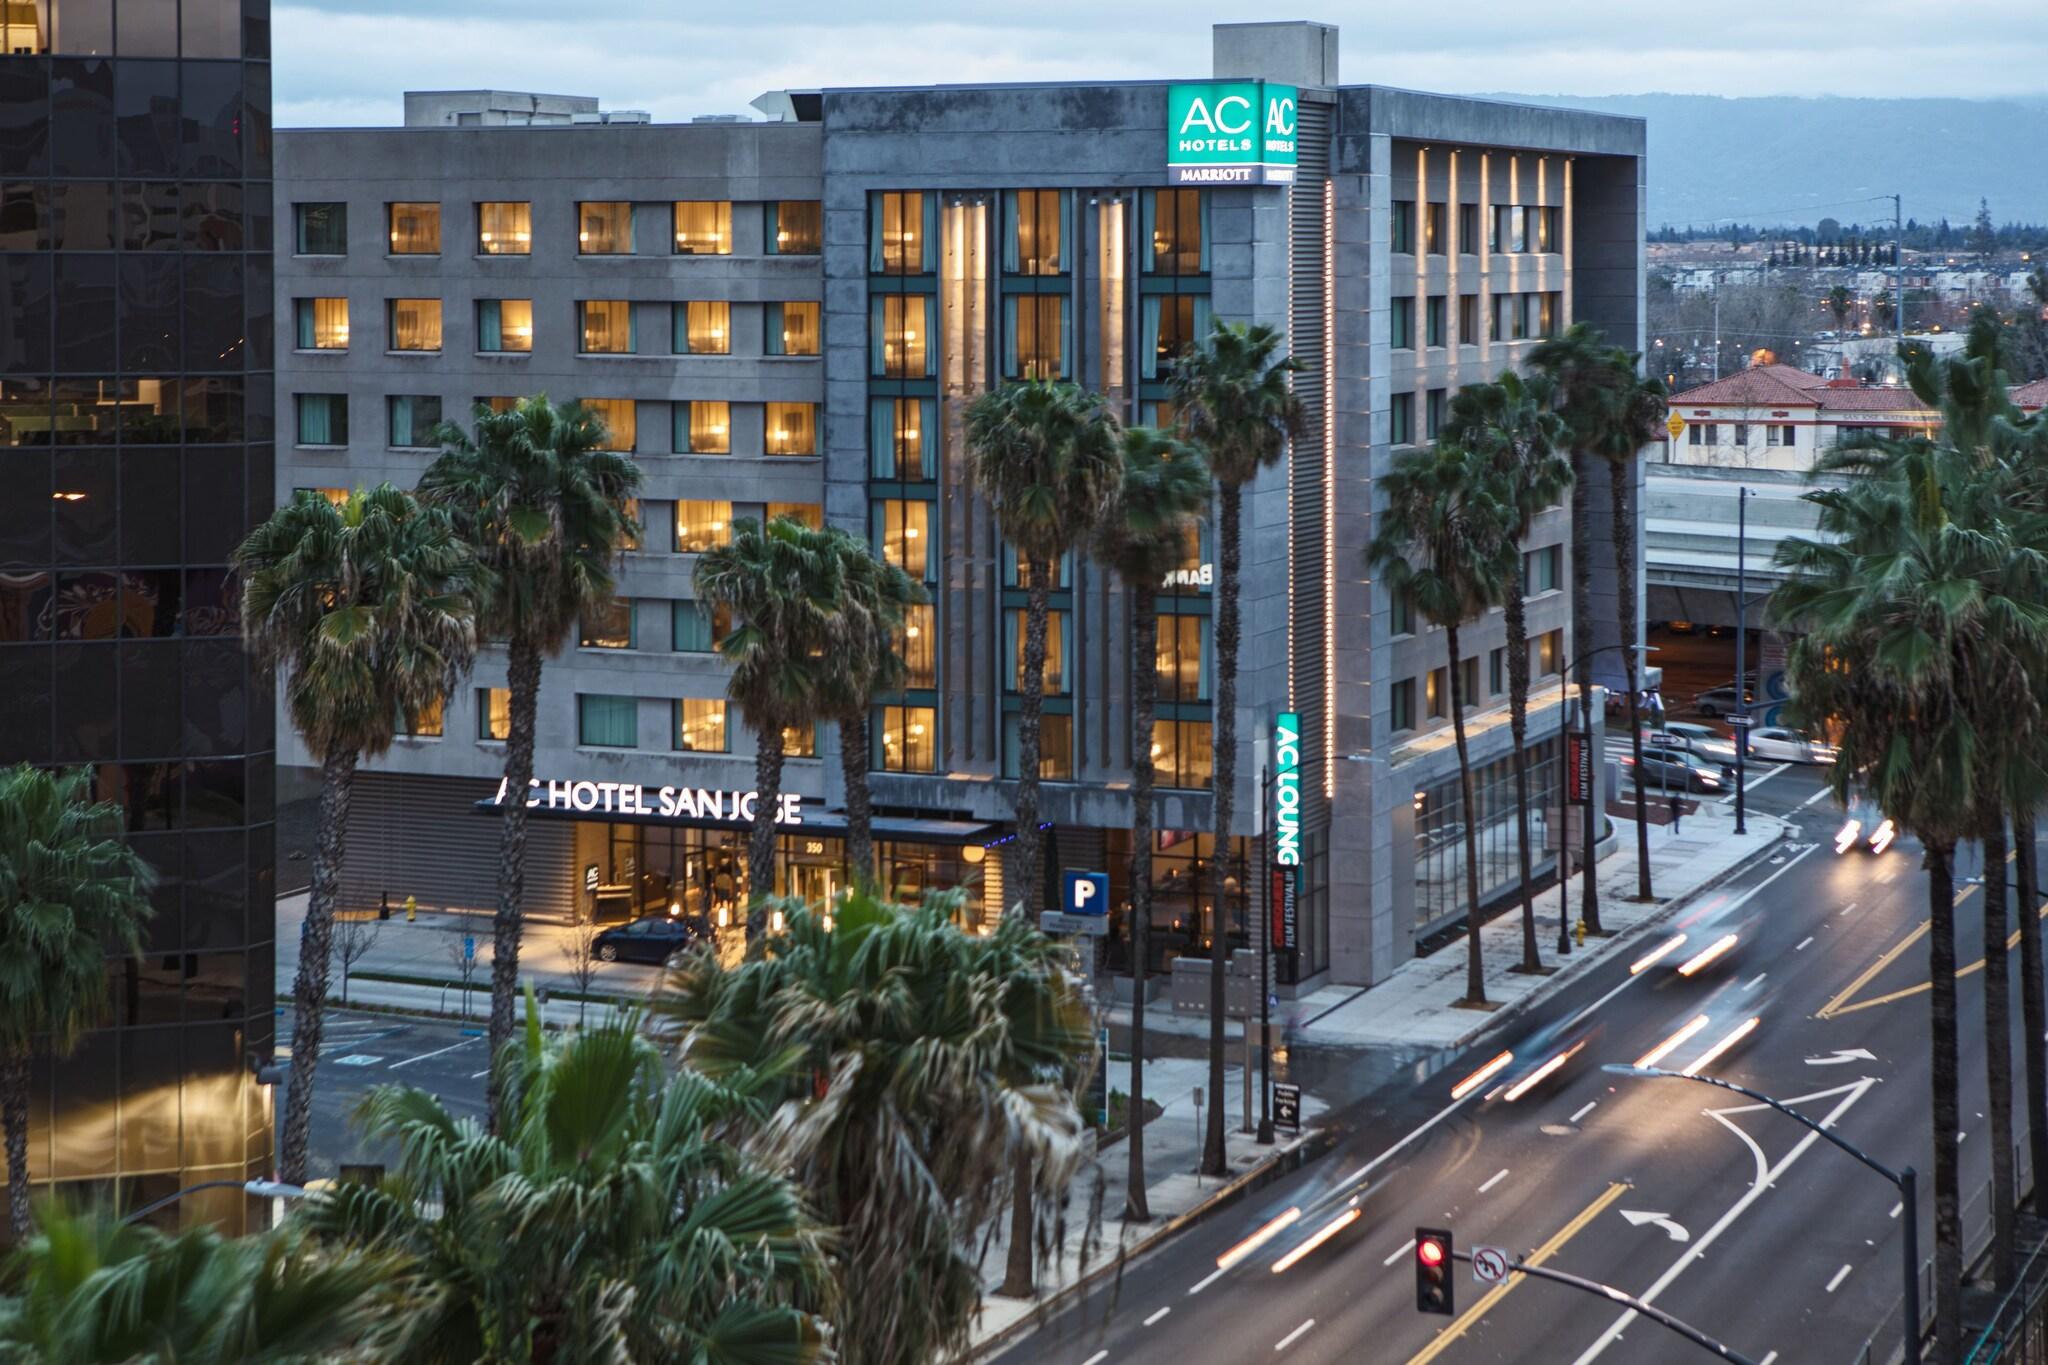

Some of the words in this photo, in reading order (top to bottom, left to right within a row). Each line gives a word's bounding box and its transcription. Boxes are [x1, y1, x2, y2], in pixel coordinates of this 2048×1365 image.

[1179, 96, 1252, 134] AC
[1265, 97, 1294, 135] AC
[1179, 139, 1252, 152] HOTELS
[1265, 140, 1294, 152] HOTELS
[1180, 169, 1252, 181] MARRIOTT
[1277, 726, 1299, 766] AC
[549, 779, 652, 815] HOTEL
[659, 785, 722, 820] SAN
[1277, 772, 1299, 866] LOUNG
[806, 842, 823, 854] 350
[1074, 879, 1096, 908] P
[1285, 883, 1295, 924] FESTIVAL
[1285, 925, 1295, 948] FILM
